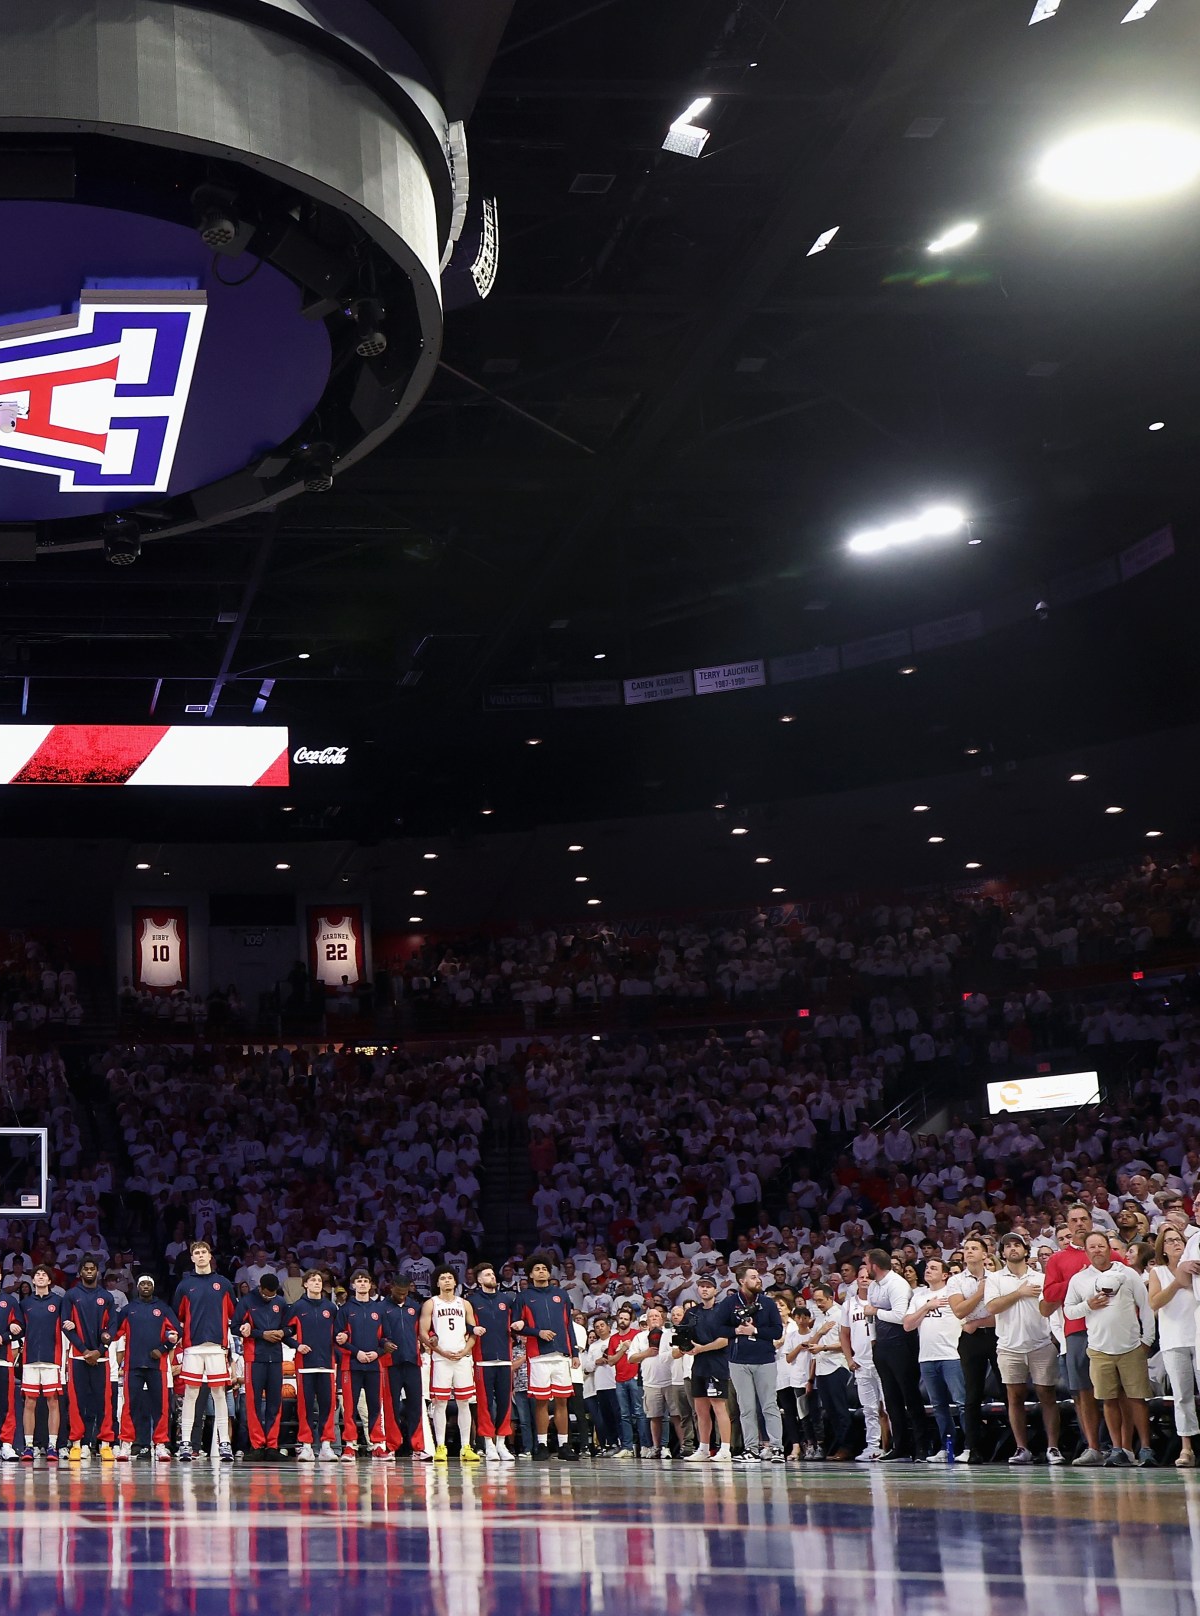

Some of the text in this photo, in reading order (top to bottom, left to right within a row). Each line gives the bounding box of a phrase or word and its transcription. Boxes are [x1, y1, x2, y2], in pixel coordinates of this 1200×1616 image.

[699, 665, 760, 681] TERRY LAUCHNER
[293, 746, 349, 765] Coca-Cola
[322, 932, 350, 941] GARDNER
[152, 944, 170, 962] 10
[326, 943, 348, 961] 22
[437, 1307, 464, 1318] ARIZONA
[448, 1318, 455, 1331] 5
